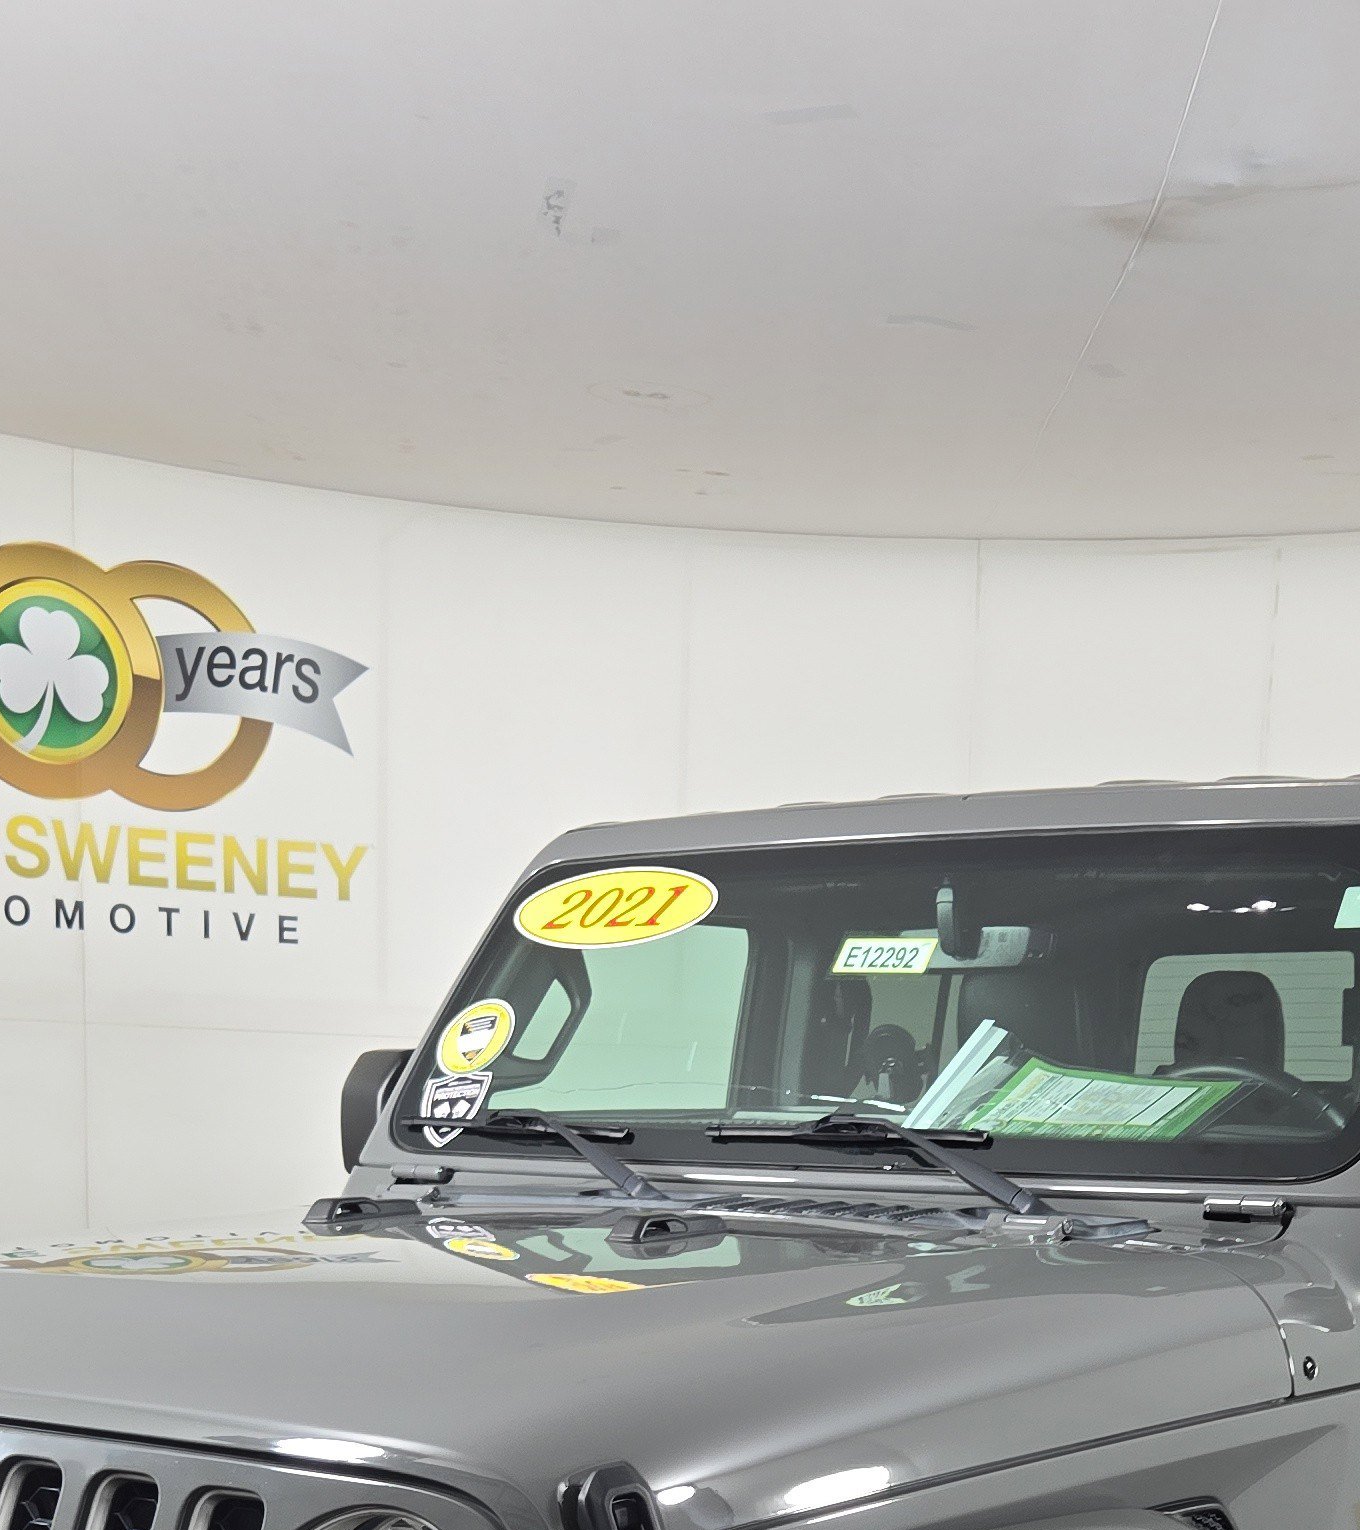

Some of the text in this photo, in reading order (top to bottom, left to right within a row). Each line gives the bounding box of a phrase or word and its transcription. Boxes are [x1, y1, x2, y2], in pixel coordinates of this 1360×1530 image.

[175, 645, 322, 703] years
[4, 815, 369, 901] SWEENEY
[541, 885, 689, 930] 2021
[843, 946, 920, 969] E12292
